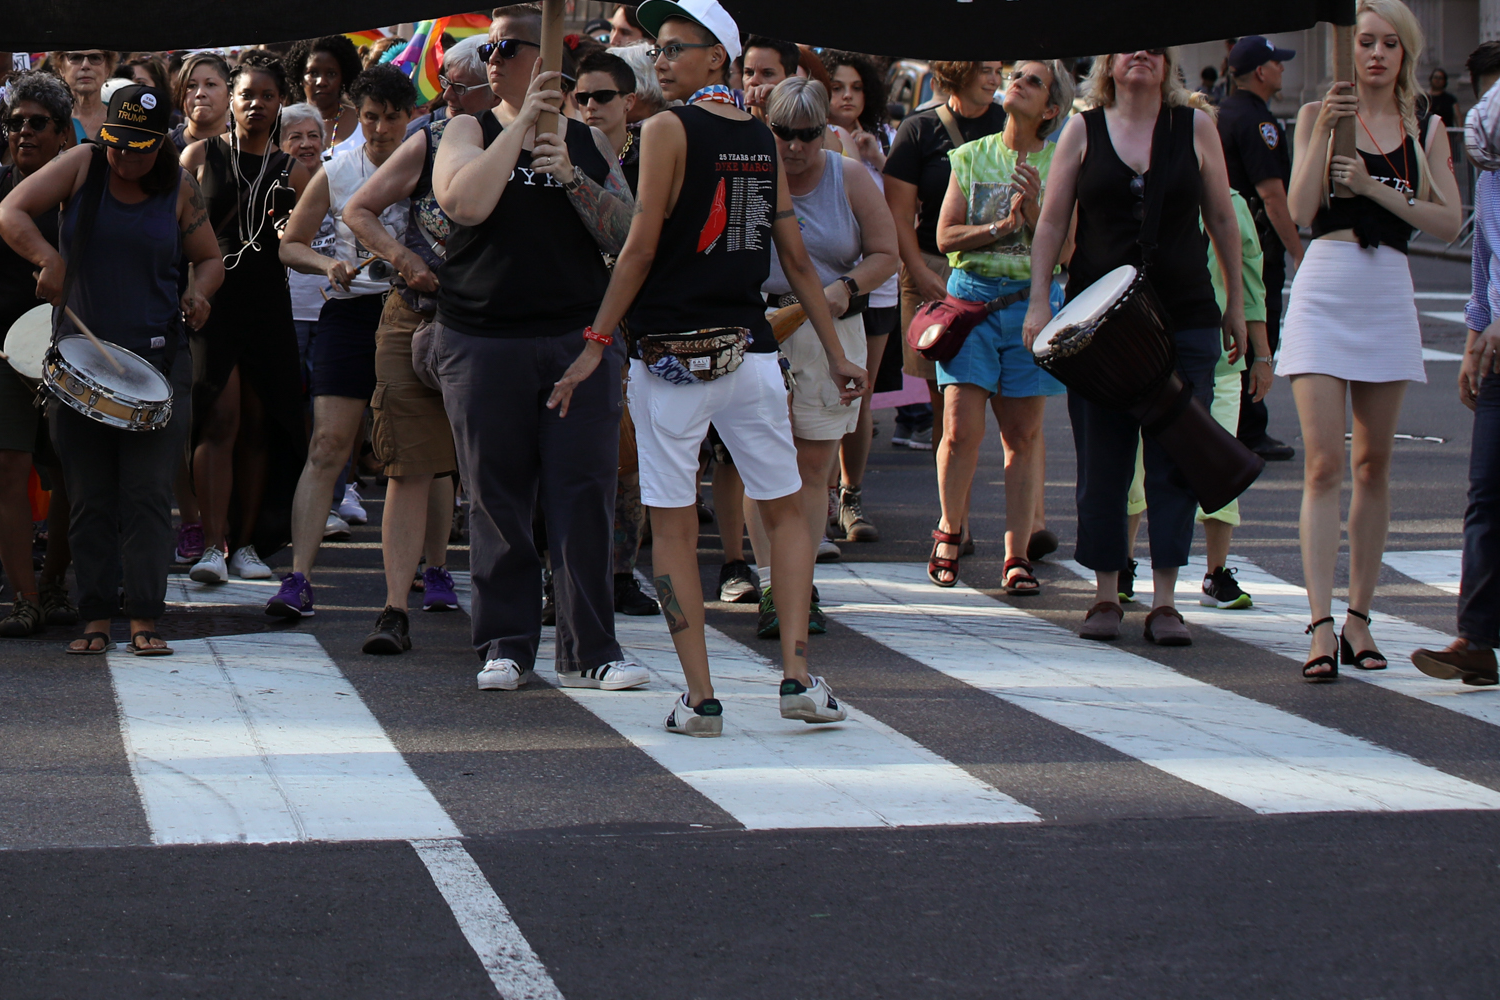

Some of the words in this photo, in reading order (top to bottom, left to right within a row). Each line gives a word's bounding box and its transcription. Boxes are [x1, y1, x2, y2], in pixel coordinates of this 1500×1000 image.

[122, 101, 145, 114] FUCK
[118, 110, 147, 122] TRUMP
[715, 163, 739, 171] DYKE
